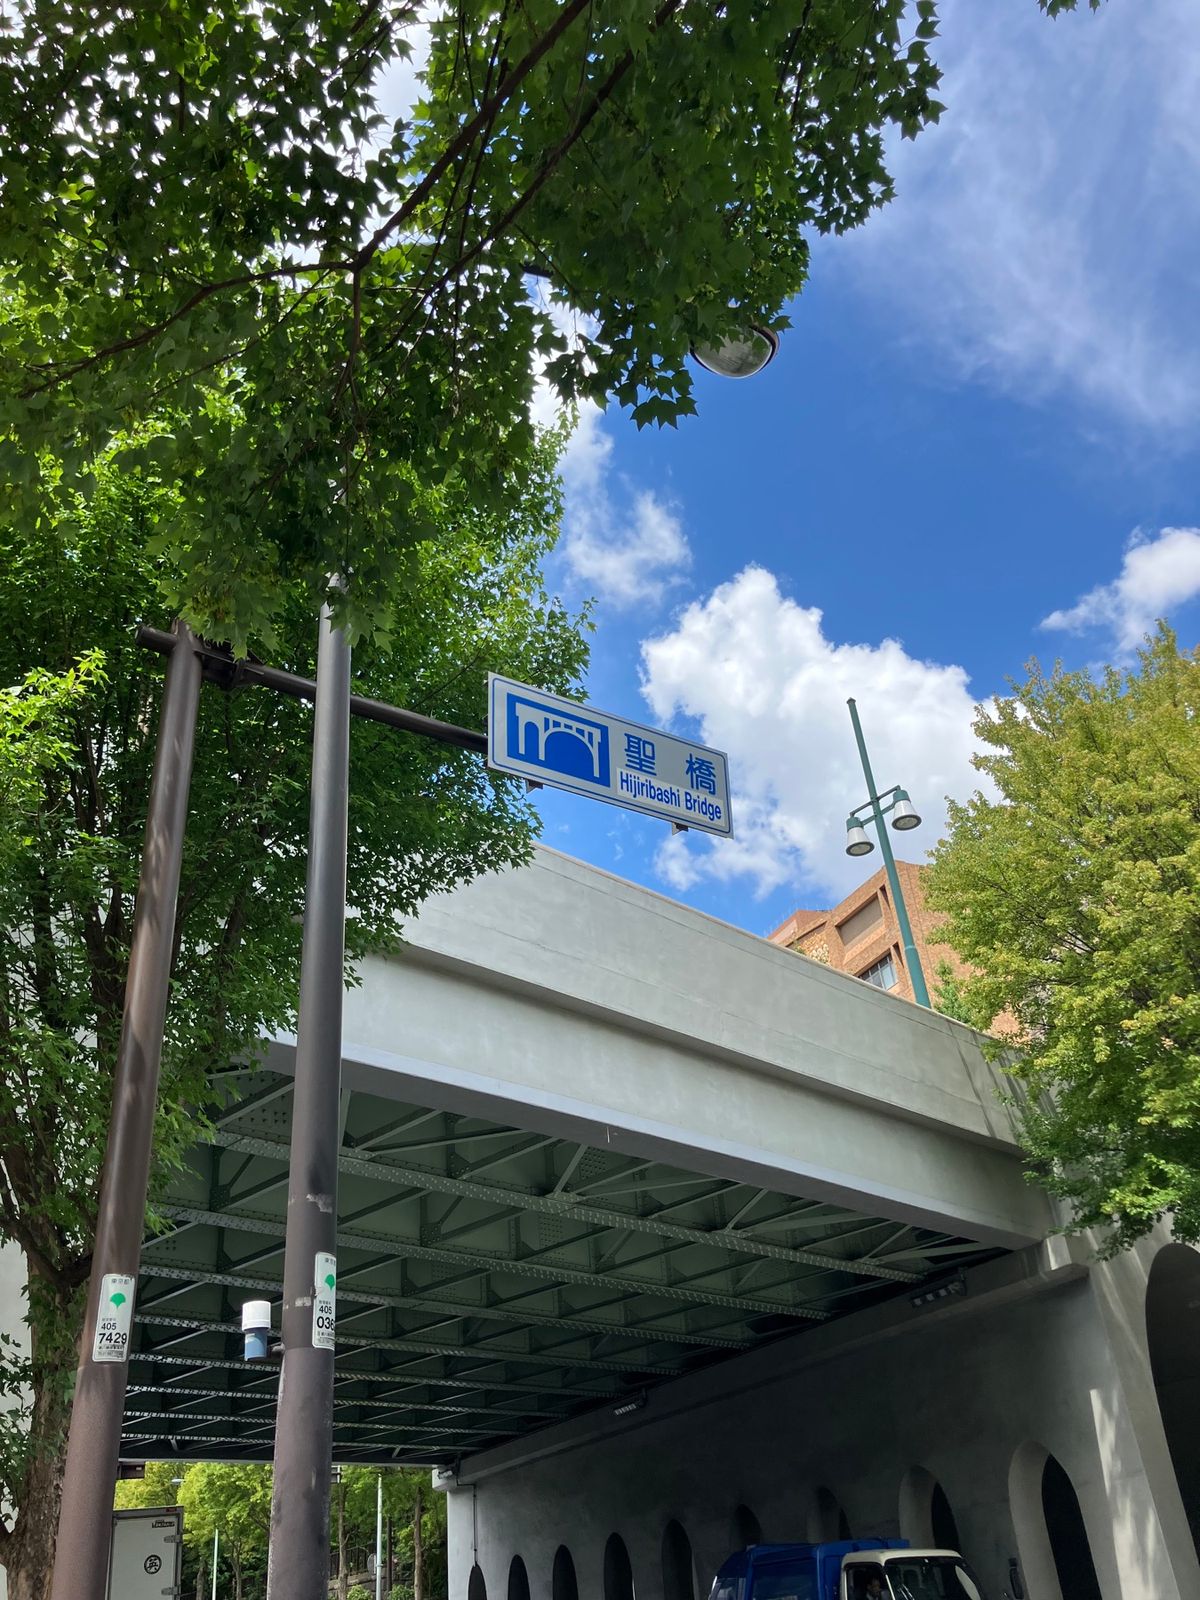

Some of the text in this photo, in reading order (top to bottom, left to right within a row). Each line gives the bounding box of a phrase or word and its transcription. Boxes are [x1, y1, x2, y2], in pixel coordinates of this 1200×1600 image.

[624, 732, 717, 796] 聖橋
[620, 771, 722, 821] Hijiribashi Bridge
[318, 1305, 333, 1315] 405
[101, 1322, 117, 1331] 405
[98, 1332, 128, 1345] 7429
